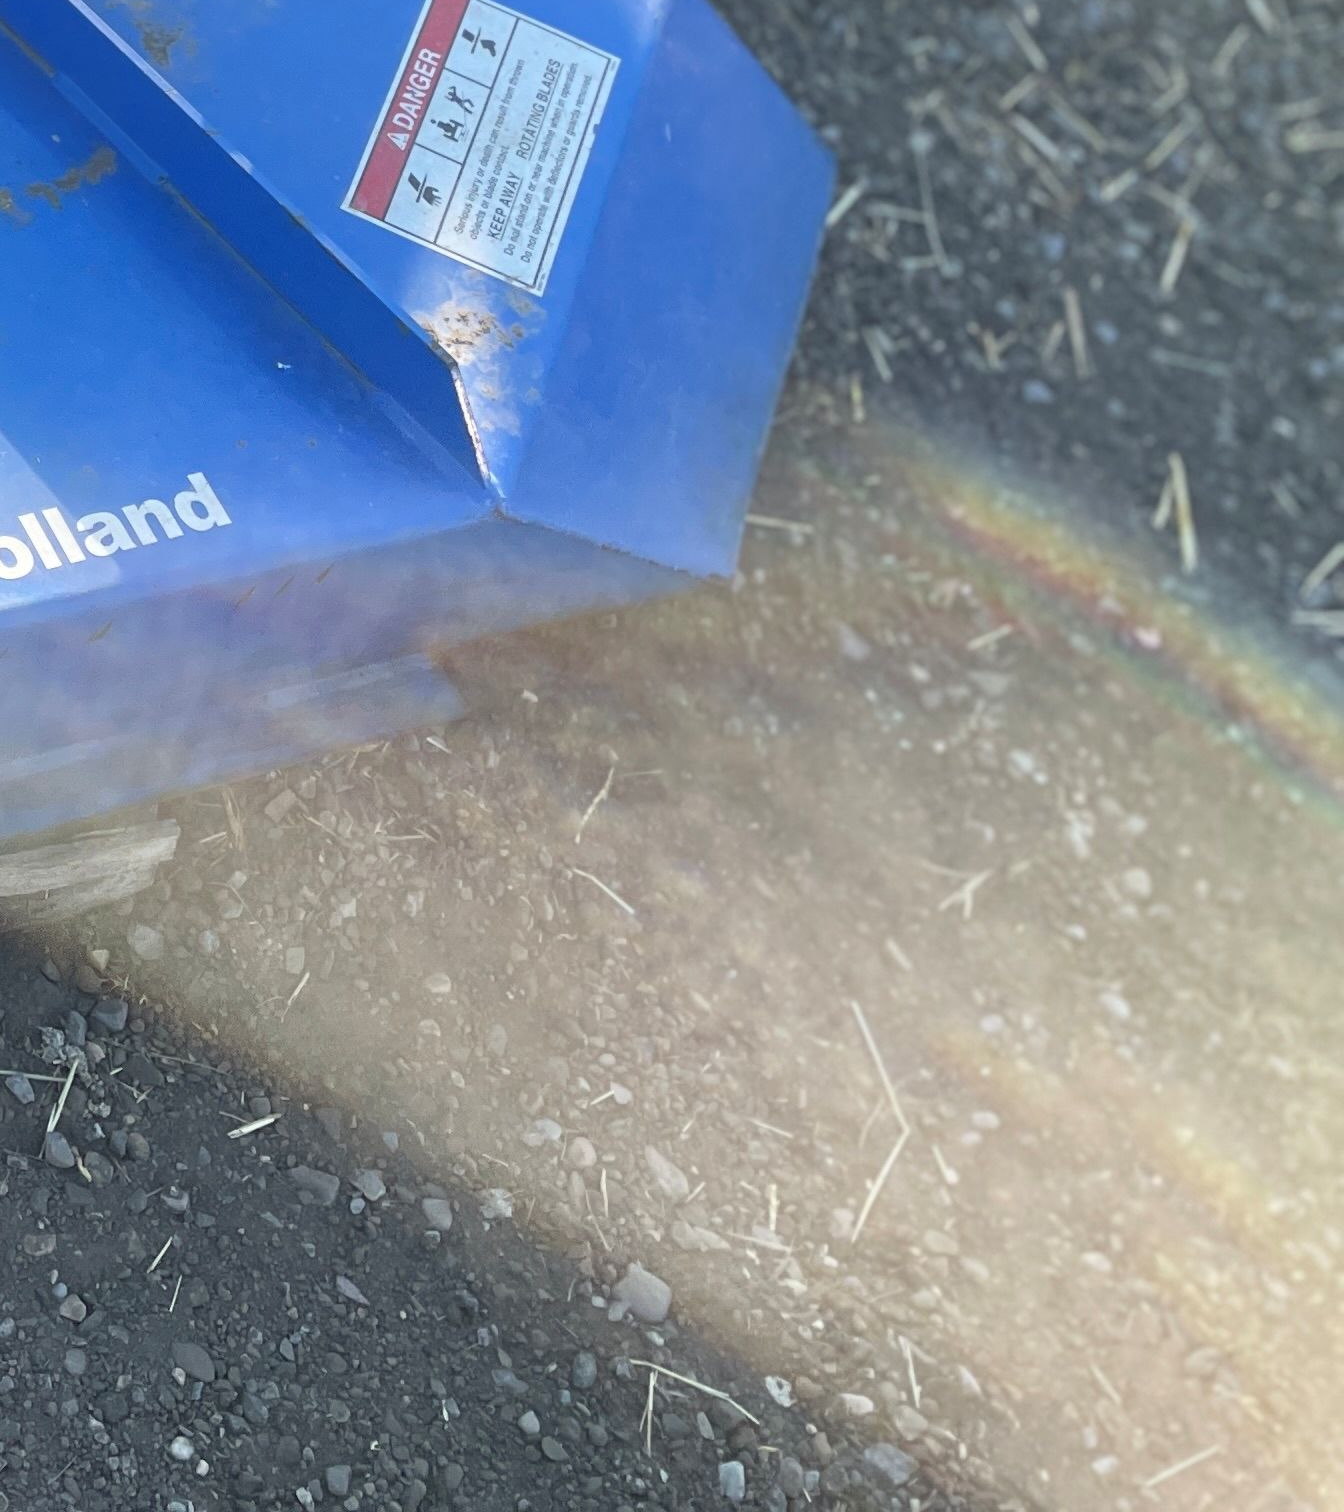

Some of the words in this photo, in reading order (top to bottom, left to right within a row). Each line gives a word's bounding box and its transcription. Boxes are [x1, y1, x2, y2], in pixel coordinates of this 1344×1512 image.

[508, 58, 525, 86] thrown
[392, 48, 441, 131] DANGER
[500, 85, 515, 105] from
[555, 98, 566, 108] in
[494, 104, 508, 128] result
[549, 107, 563, 128] when
[565, 108, 582, 136] guards
[488, 128, 500, 144] can
[537, 128, 555, 162] machine
[562, 135, 571, 146] or
[478, 144, 494, 167] death
[486, 207, 506, 240] KEEP
[498, 171, 520, 207] AWAY
[515, 102, 544, 159] ROTATING
[535, 58, 560, 102] BLADES
[475, 166, 485, 177] or
[530, 163, 543, 181] near
[546, 146, 568, 185] deflectors
[464, 176, 483, 202] injury
[482, 175, 498, 199] blade
[527, 181, 537, 192] or
[542, 185, 554, 203] with
[480, 199, 489, 209] or
[523, 192, 533, 205] on
[453, 202, 472, 234] Serious
[469, 210, 486, 239] objects
[514, 203, 529, 228] stand
[531, 203, 550, 235] operate
[508, 227, 520, 242] not
[526, 235, 537, 250] not
[503, 242, 515, 256] Do
[520, 250, 533, 263] Do
